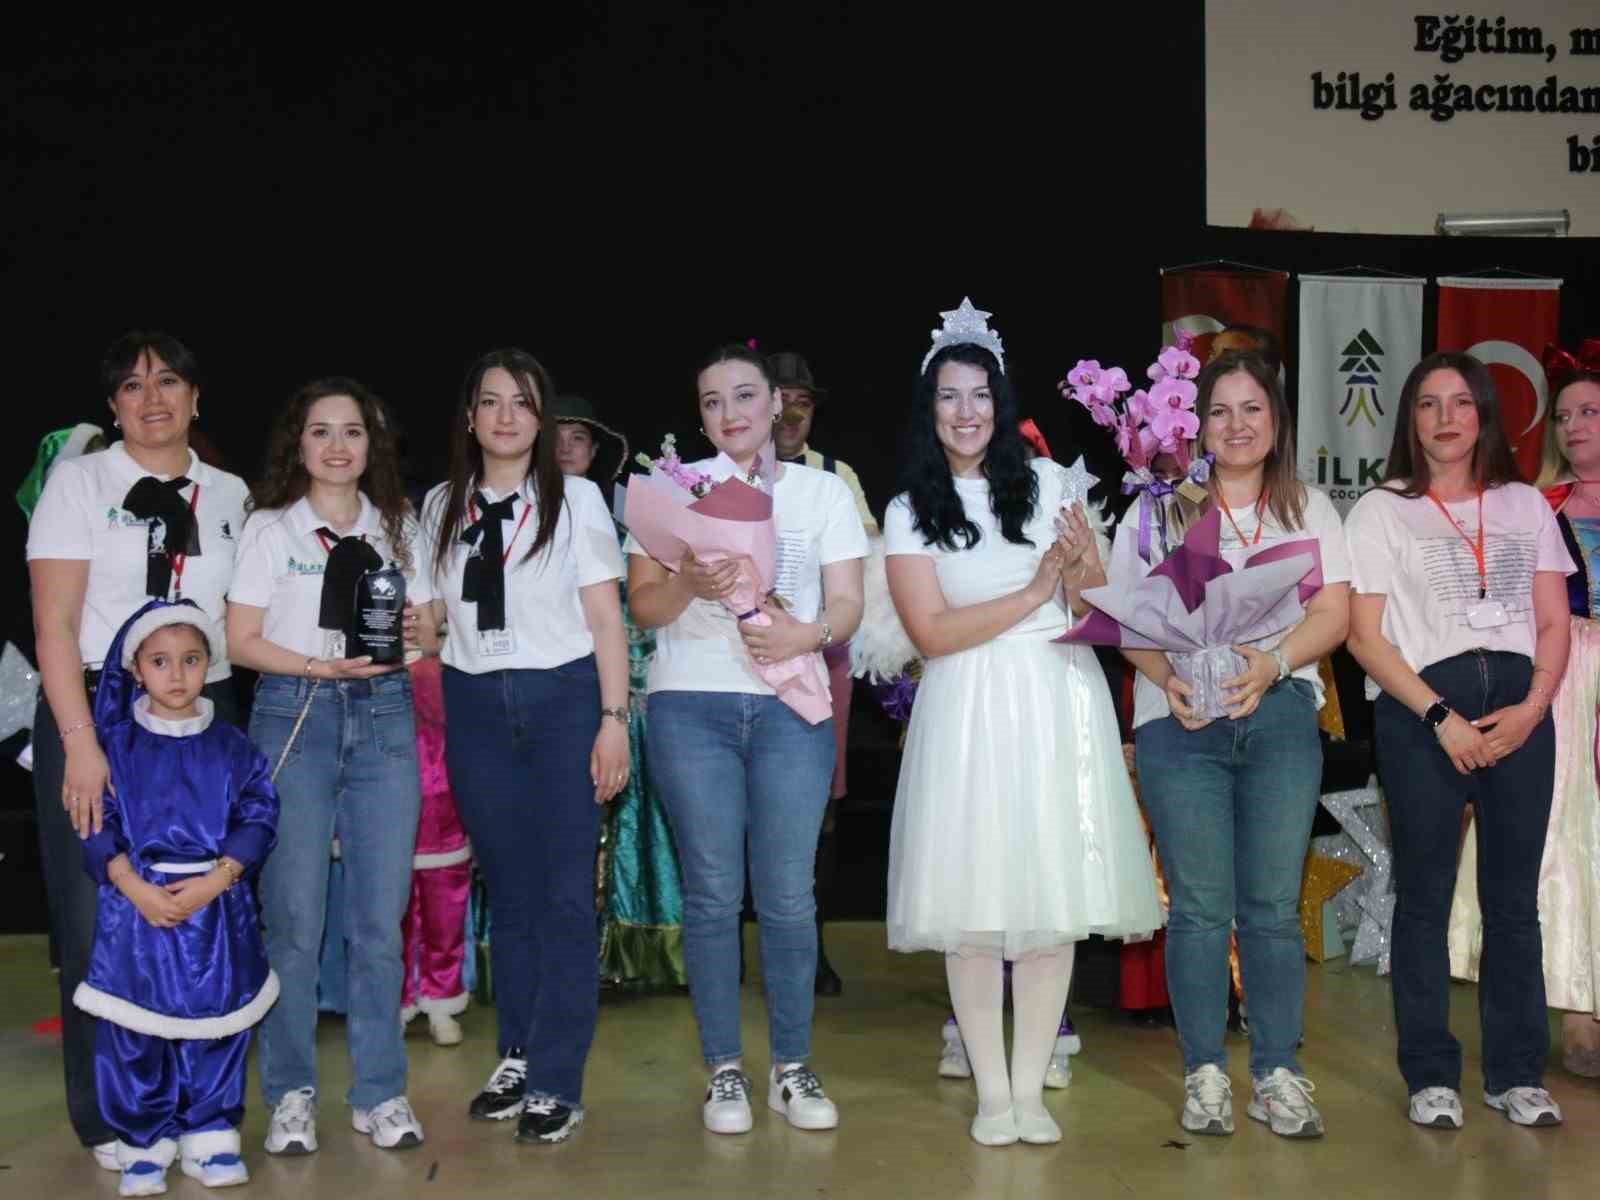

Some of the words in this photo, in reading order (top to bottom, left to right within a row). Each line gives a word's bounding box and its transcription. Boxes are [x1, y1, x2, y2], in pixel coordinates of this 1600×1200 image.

[1414, 14, 1557, 64] Eğitim,
[1311, 72, 1397, 121] bilgi
[1409, 73, 1600, 122] ağacından
